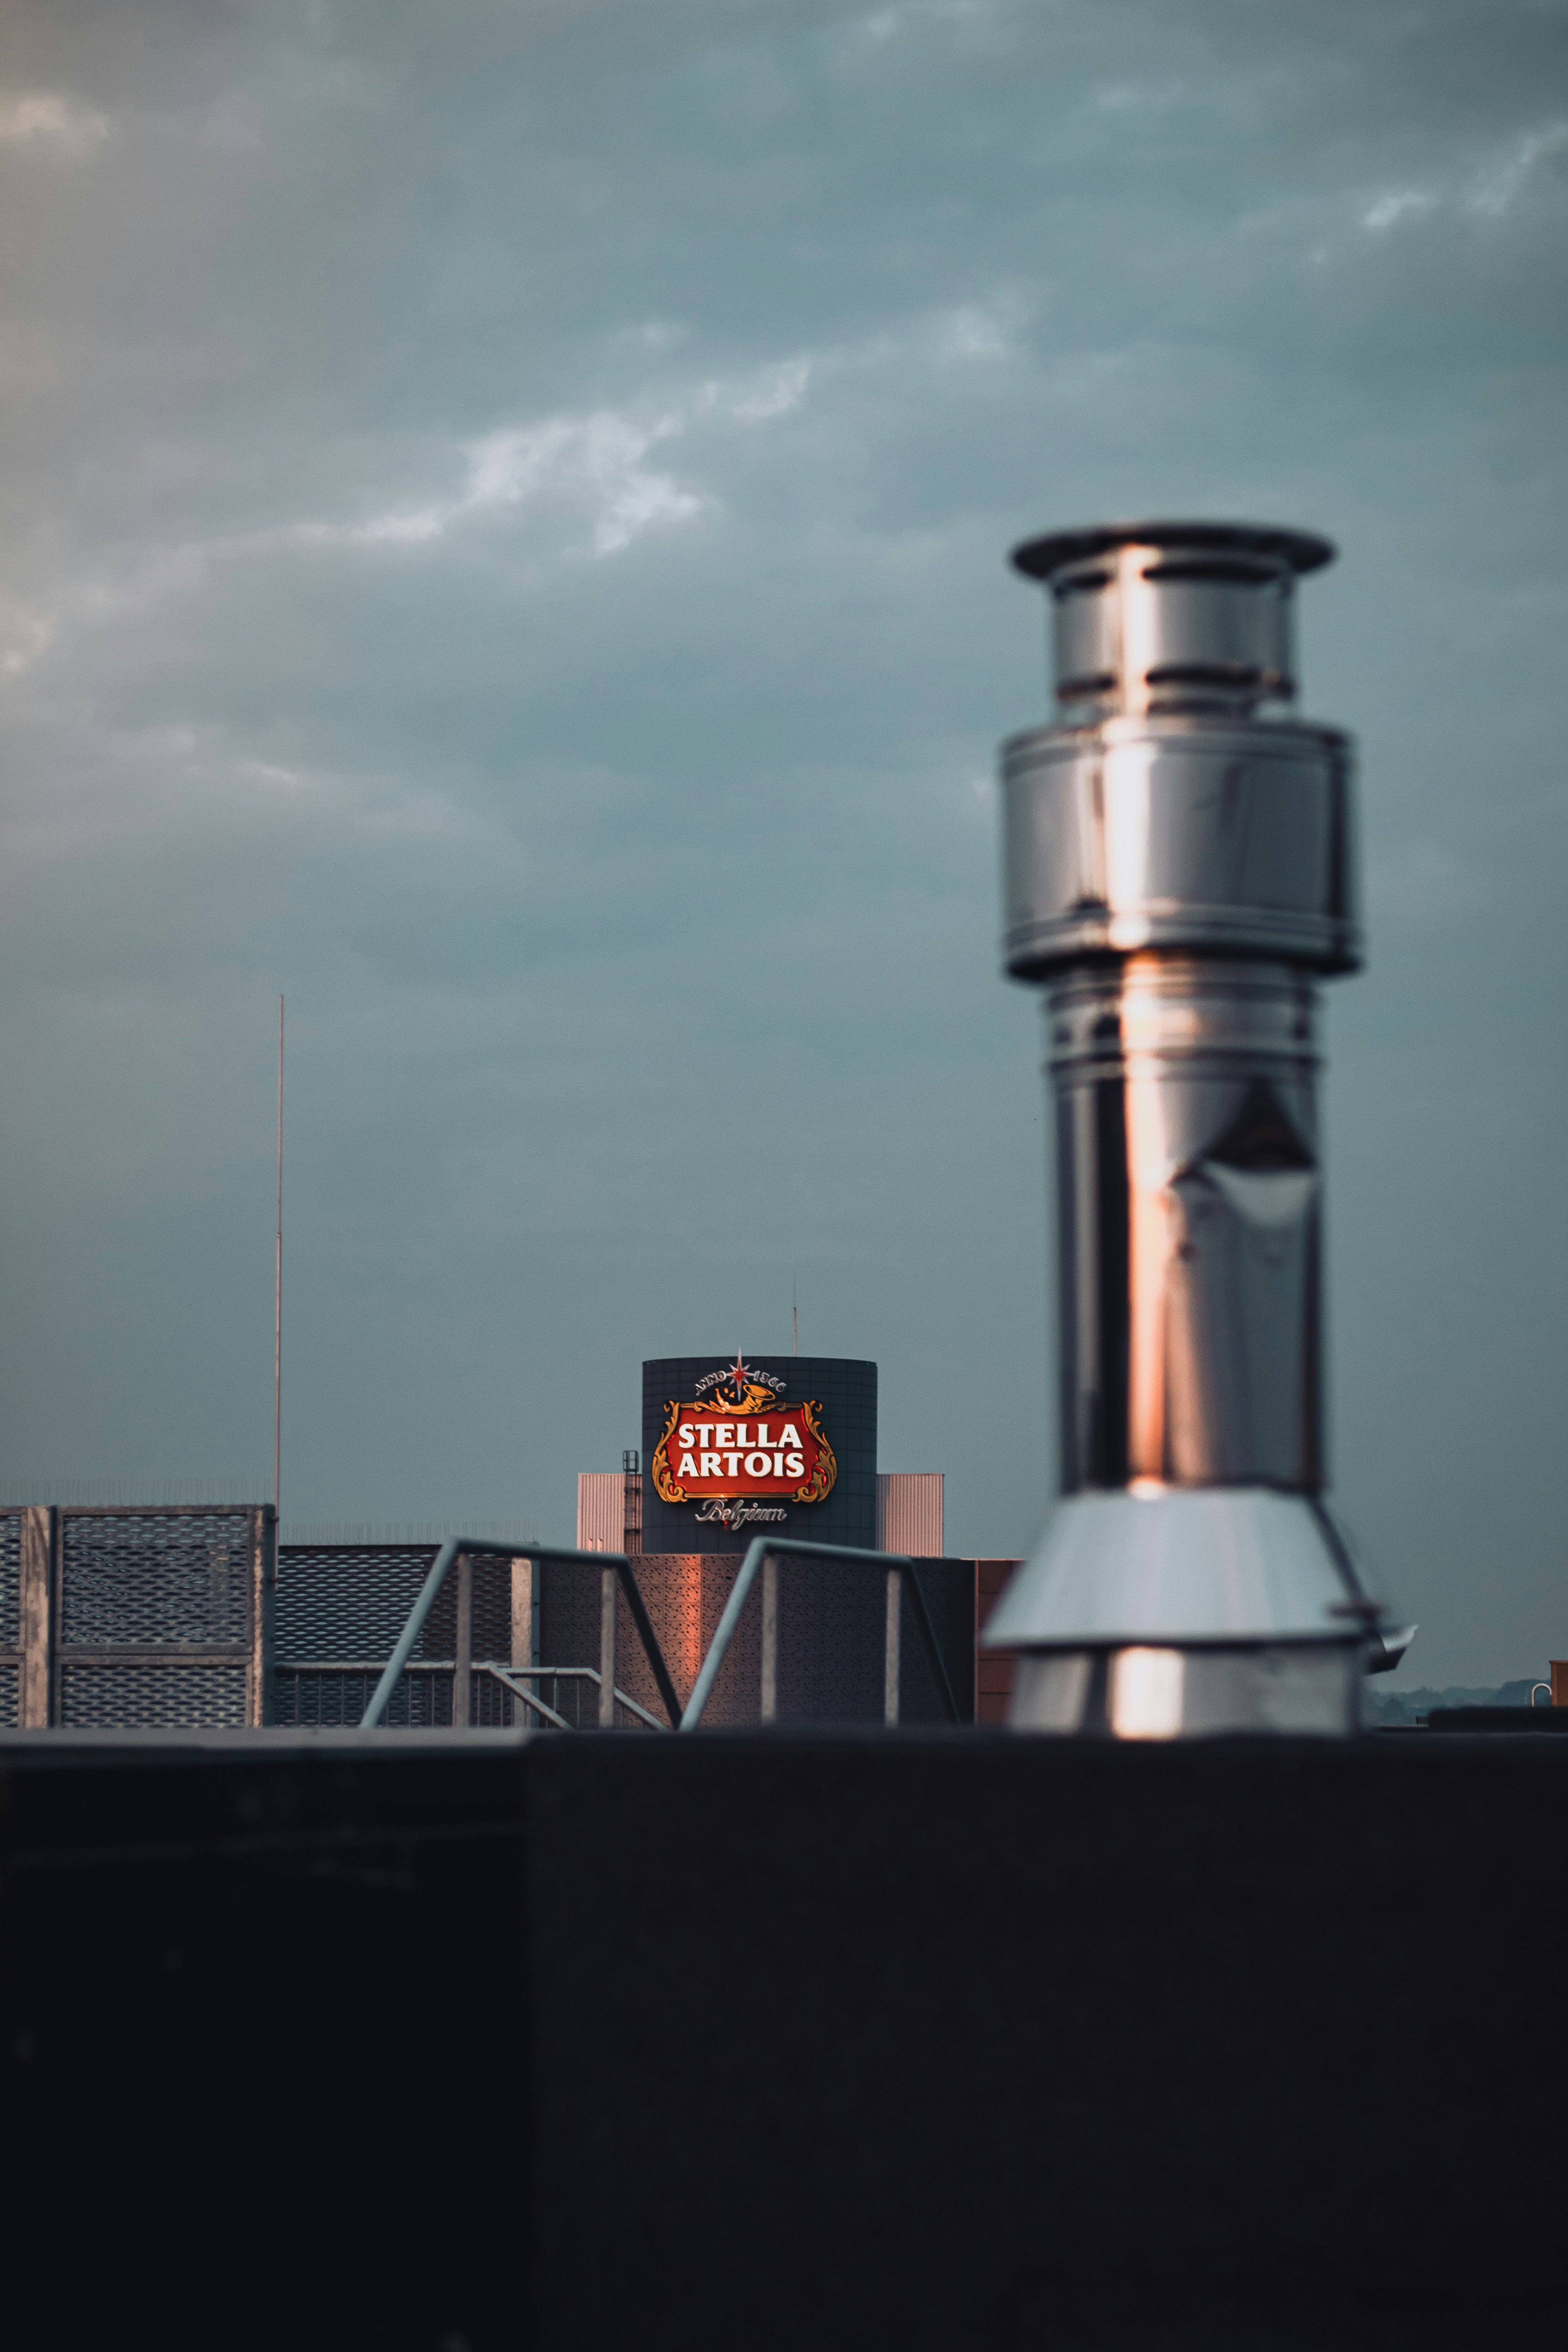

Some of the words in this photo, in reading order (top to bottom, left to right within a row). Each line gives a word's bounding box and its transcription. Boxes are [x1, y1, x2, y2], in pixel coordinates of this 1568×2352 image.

[695, 1370, 726, 1396] ANNO
[678, 1423, 803, 1448] STELLA
[677, 1452, 805, 1477] ARTOIS
[695, 1498, 787, 1530] Belgium
